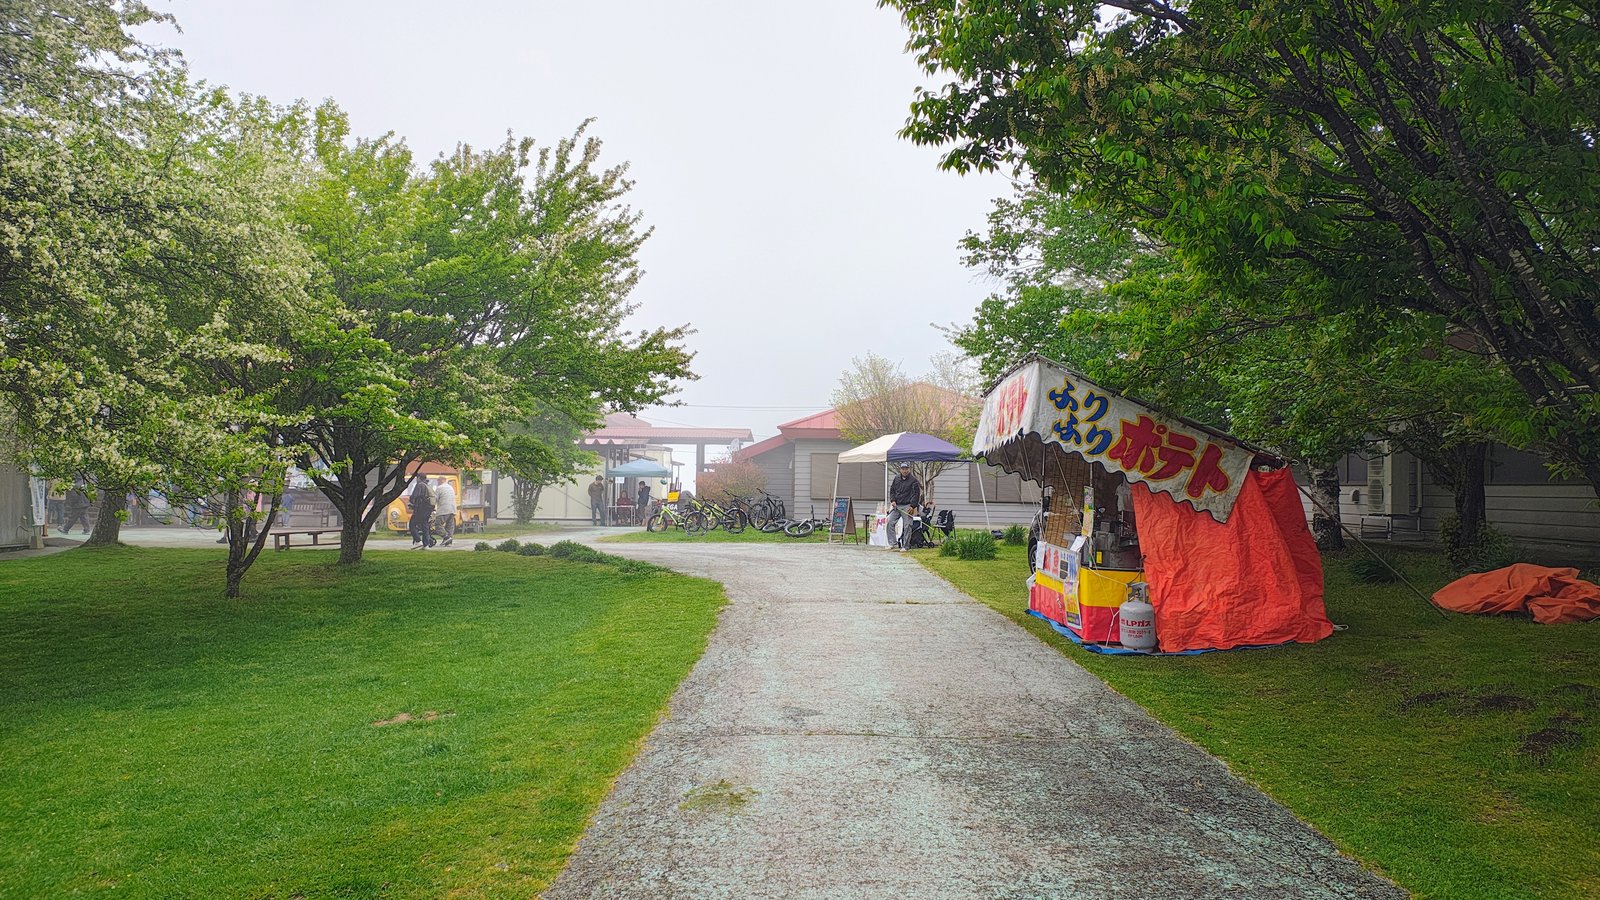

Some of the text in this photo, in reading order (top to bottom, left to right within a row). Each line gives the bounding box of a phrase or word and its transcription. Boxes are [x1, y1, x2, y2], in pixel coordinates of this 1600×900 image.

[1049, 379, 1109, 422] ふり
[1053, 412, 1113, 456] ふり
[1107, 414, 1231, 499] ポテト
